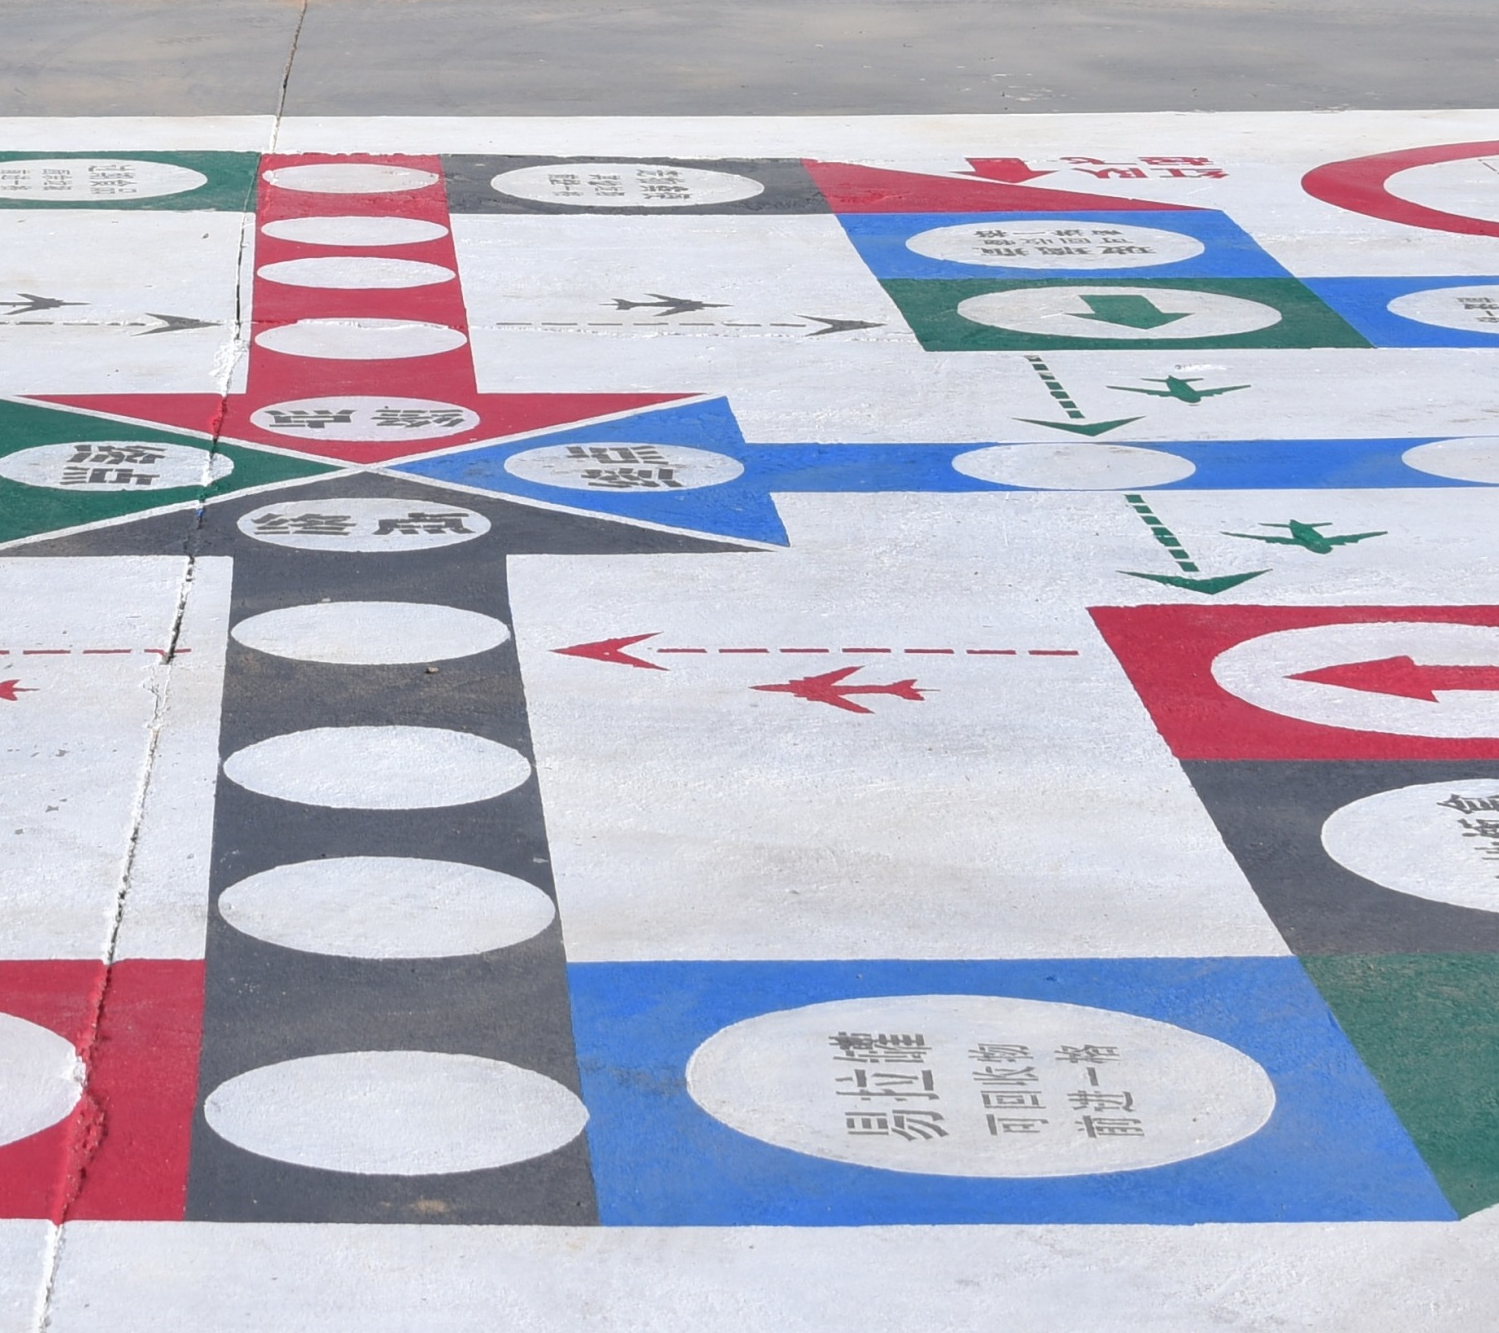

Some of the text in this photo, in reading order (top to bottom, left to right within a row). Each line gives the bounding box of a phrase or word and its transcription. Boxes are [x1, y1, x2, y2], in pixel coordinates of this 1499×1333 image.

[86, 164, 138, 195] 过期食品
[1072, 168, 1228, 180] 红队
[973, 245, 1157, 257] 玻璃瓶
[264, 407, 472, 430] 终点
[56, 442, 168, 488] 终点
[564, 442, 684, 489] 终点
[253, 510, 472, 536] 终点
[828, 1031, 949, 1142] 易拉罐
[968, 1041, 1050, 1138] 可回收物
[1055, 1042, 1145, 1139] 前进一格
